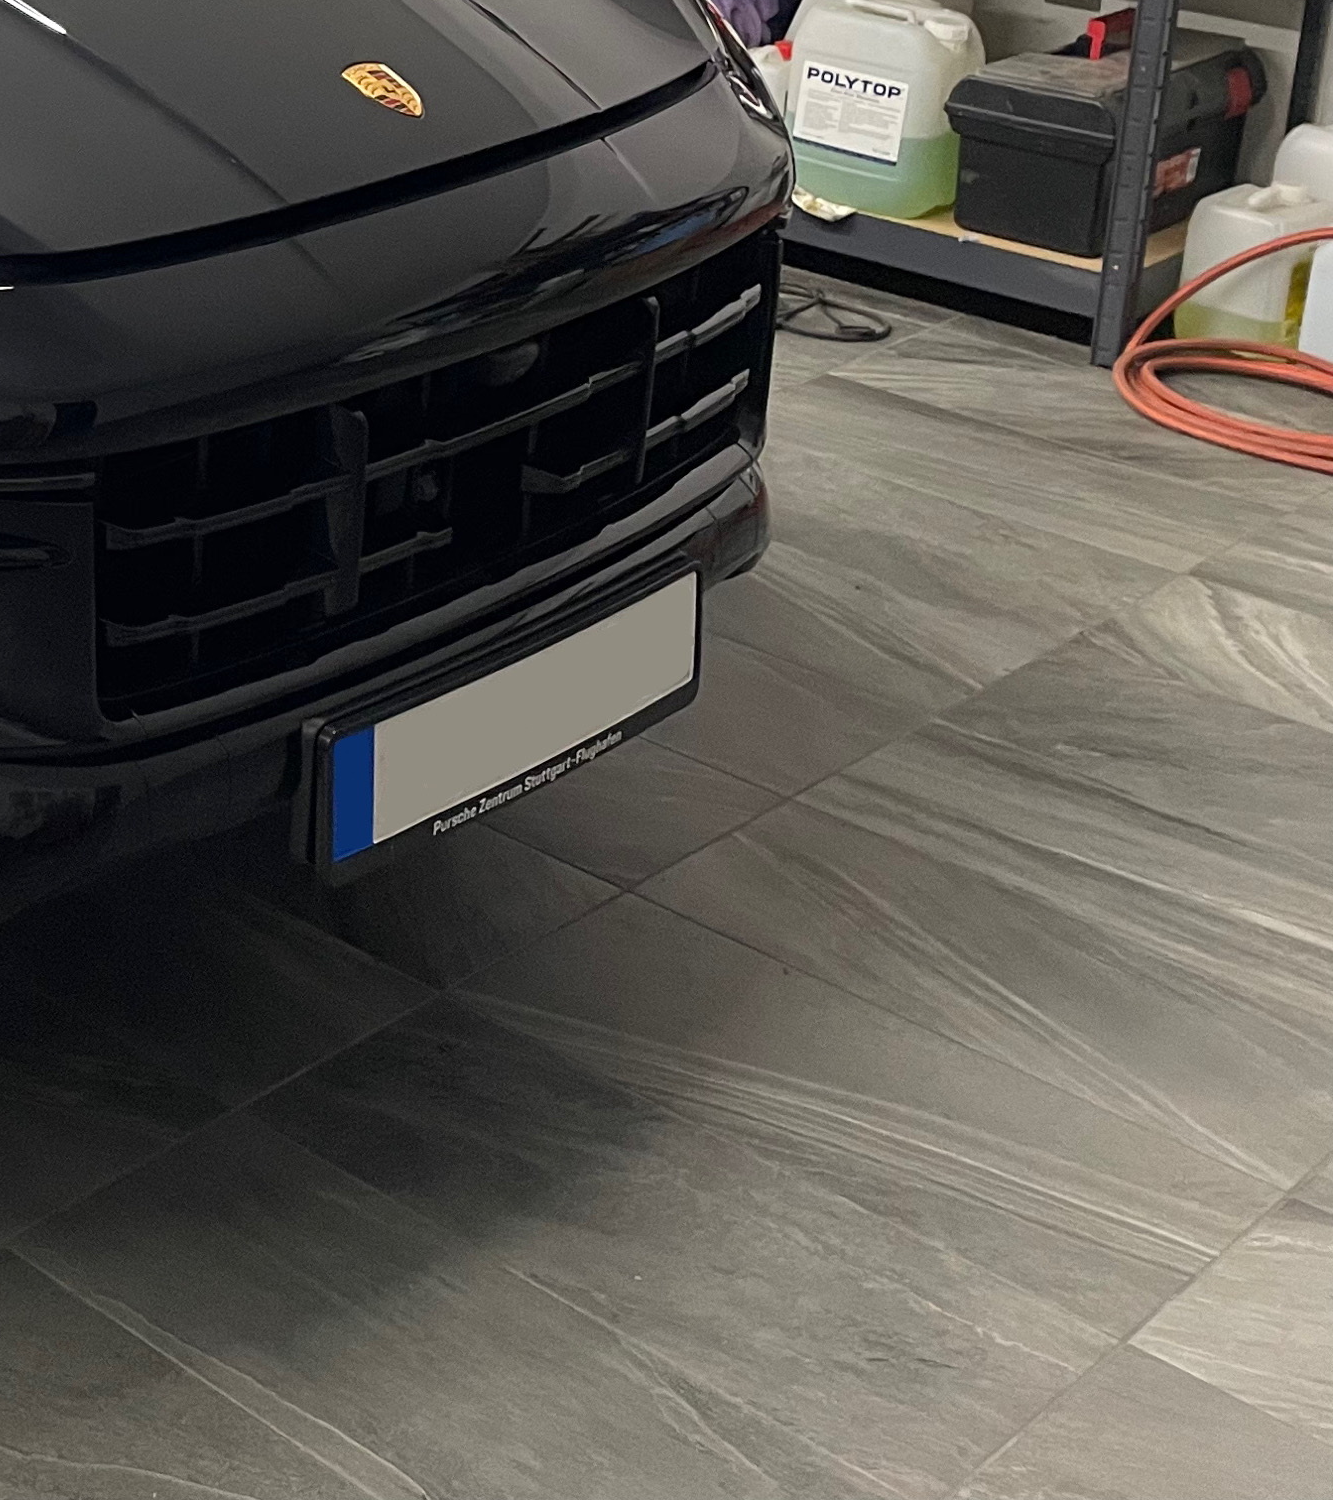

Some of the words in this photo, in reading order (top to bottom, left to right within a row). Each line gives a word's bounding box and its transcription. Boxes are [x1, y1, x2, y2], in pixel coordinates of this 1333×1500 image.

[807, 67, 901, 98] POLYTOP
[479, 784, 523, 813] Zentrum
[524, 731, 623, 791] Stuttgart-Flughafen
